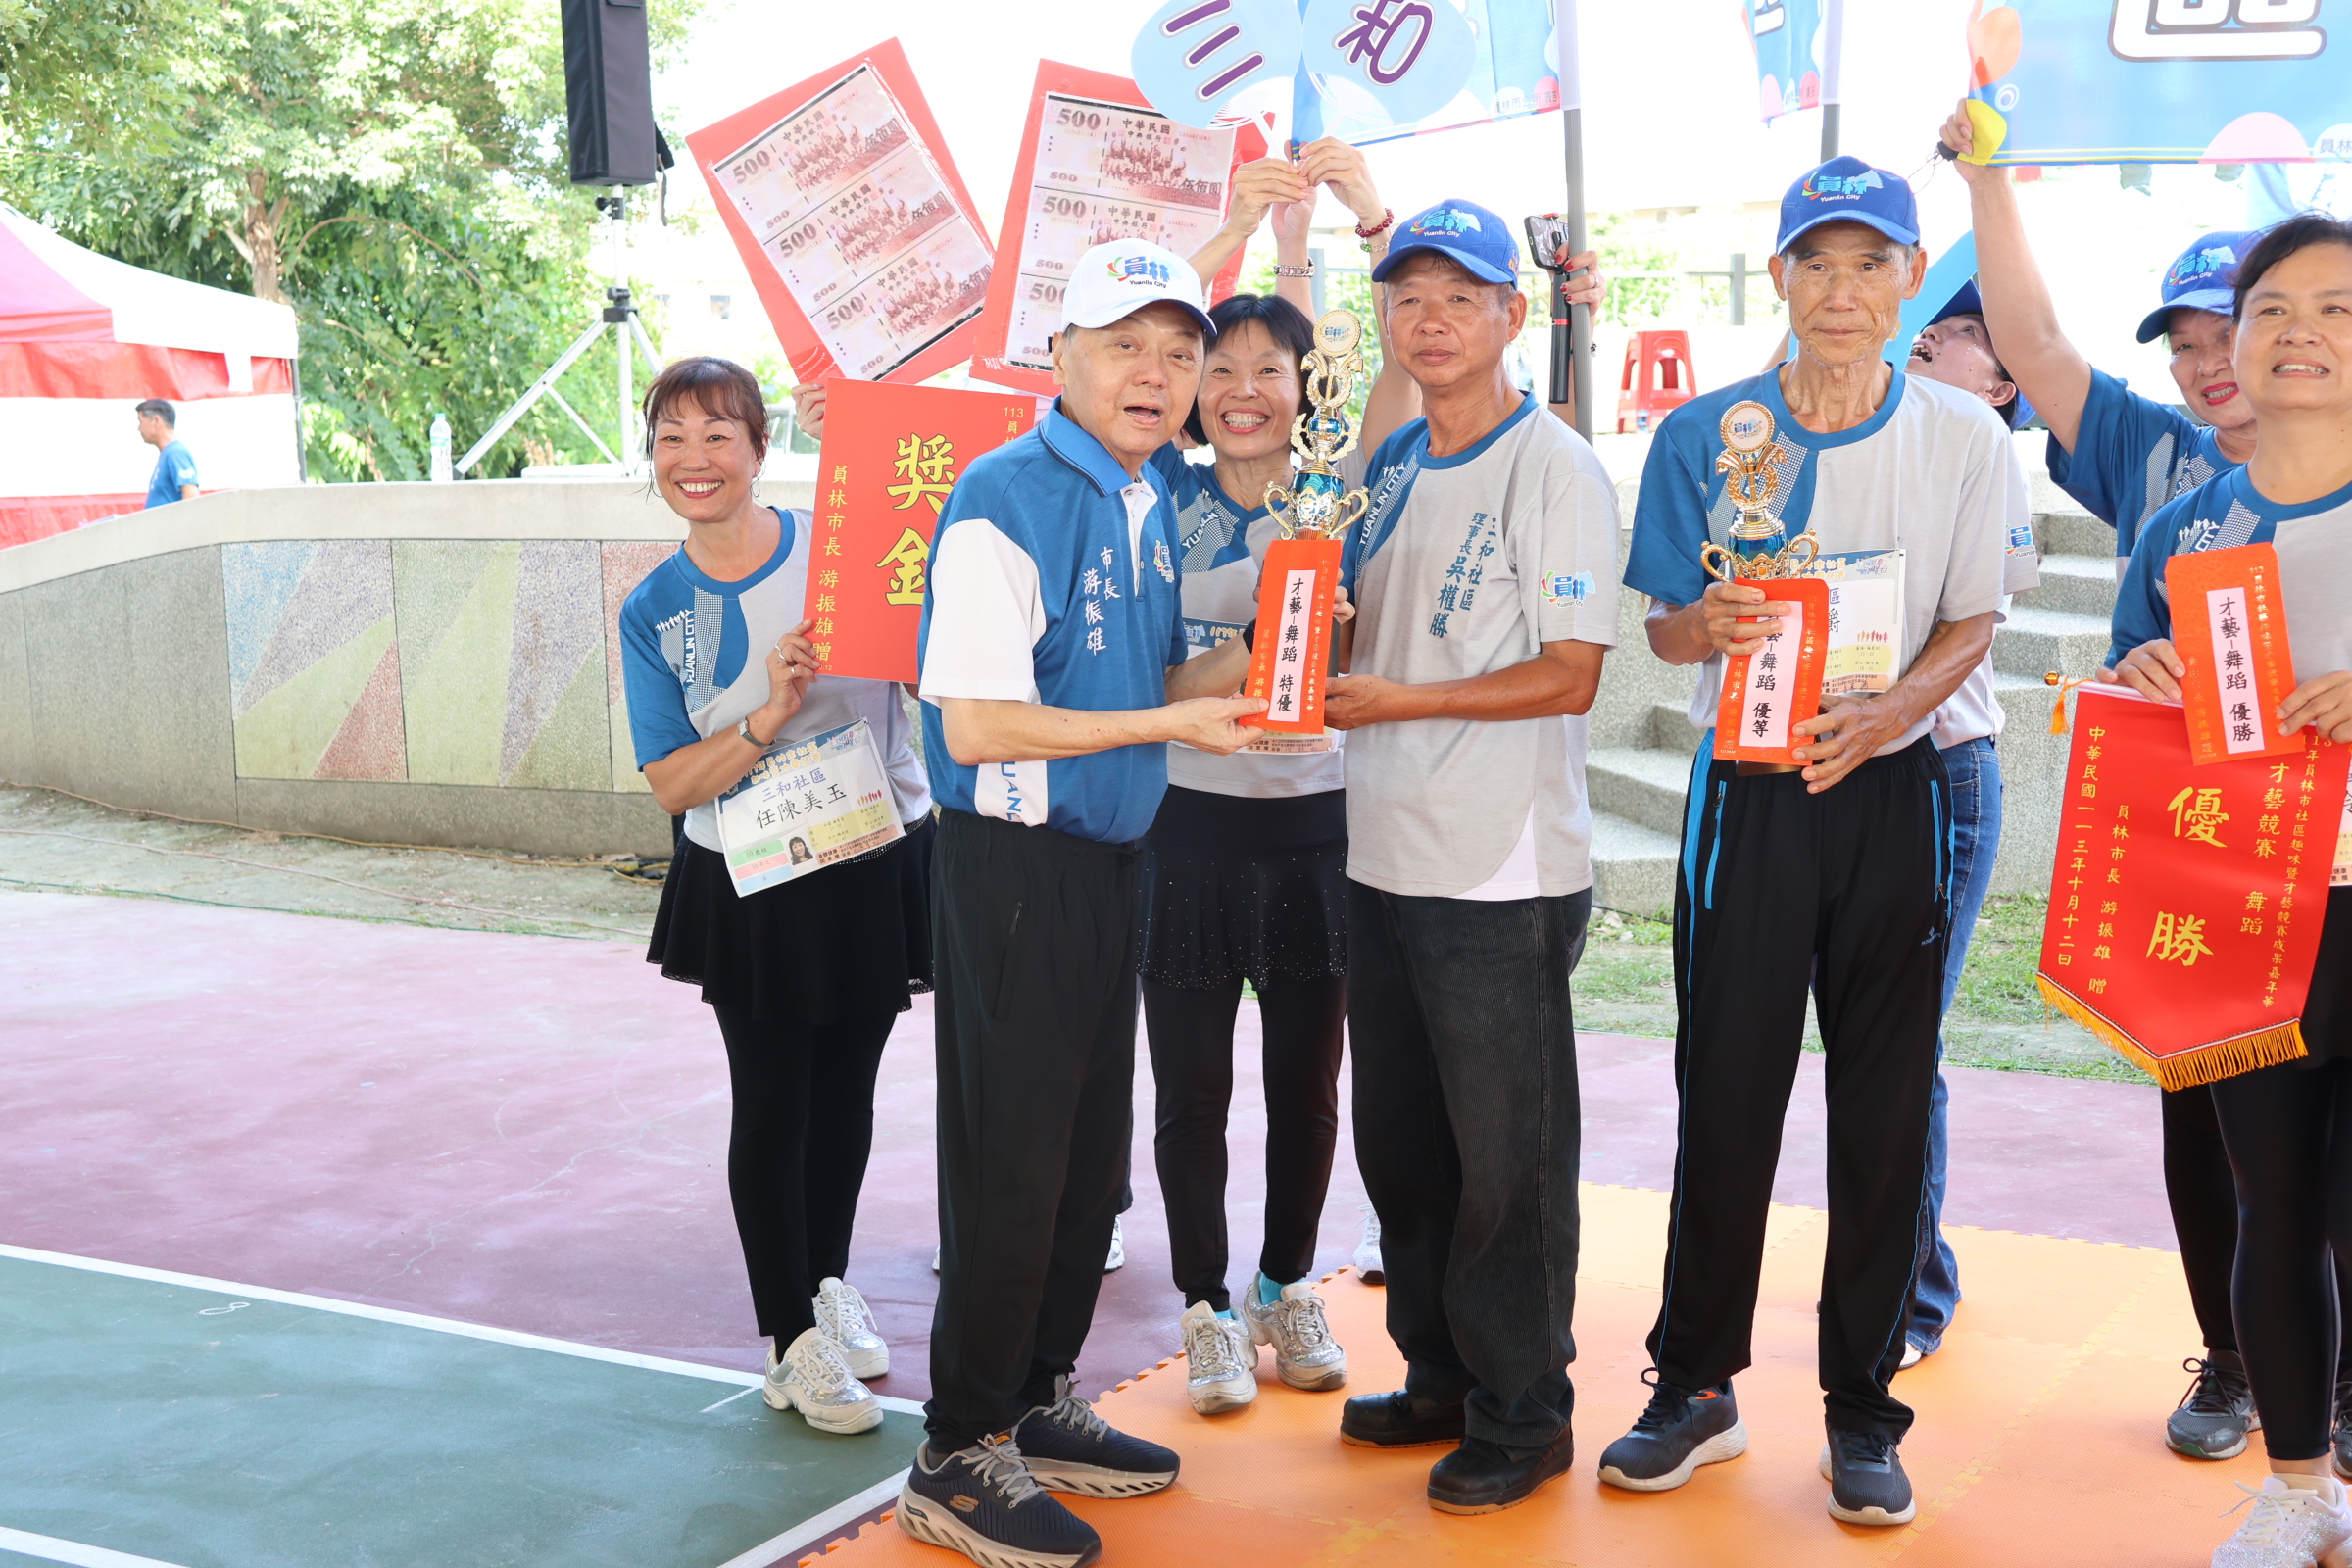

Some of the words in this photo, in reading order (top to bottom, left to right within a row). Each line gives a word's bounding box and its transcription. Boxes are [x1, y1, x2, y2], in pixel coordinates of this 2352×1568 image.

[1164, 0, 1264, 98] 三
[782, 110, 825, 143] 中華民國
[1056, 107, 1101, 130] 500
[1122, 118, 1171, 135] 中華民國
[732, 149, 771, 185] 500
[1049, 171, 1078, 183] 500
[829, 183, 872, 216] 中華民國
[1181, 177, 1222, 196] 伍佰圓
[1817, 175, 1867, 195] 員林
[765, 209, 790, 229] 500
[1042, 195, 1087, 218] 500
[1107, 204, 1156, 222] 中華民國
[779, 222, 817, 258] 500
[876, 256, 919, 289] 中華民國
[1035, 259, 1064, 270] 500
[1125, 256, 1170, 282] 員林
[2178, 275, 2199, 286] Yuanlin
[812, 281, 837, 303] 500
[826, 295, 865, 330] 500
[859, 354, 885, 374] 500
[823, 465, 848, 557] 員林市長
[875, 431, 956, 606] 獎金
[1359, 490, 1389, 546] YUANLIN
[1387, 462, 1405, 492] CITY
[2194, 520, 2221, 552] CITY
[1100, 546, 1121, 601] 市長
[1459, 516, 1497, 612] 三和社區
[1554, 575, 1586, 601] 員林
[685, 609, 694, 635] CITY
[1083, 567, 1107, 656] 游振雄
[685, 638, 696, 684] YUANLIN
[1277, 674, 1294, 712] 特優
[1751, 701, 1773, 738] 優等
[2230, 702, 2255, 742] 優勝
[761, 766, 826, 803] 三和社區
[756, 783, 848, 829] 任陳美玉
[2253, 762, 2290, 859] 才藝競賽
[2106, 804, 2130, 885] 員林市長
[2145, 786, 2230, 966] 優勝
[2092, 900, 2119, 960] 游振雄
[2239, 890, 2268, 935] 舞蹈
[2087, 977, 2108, 995] 贈
